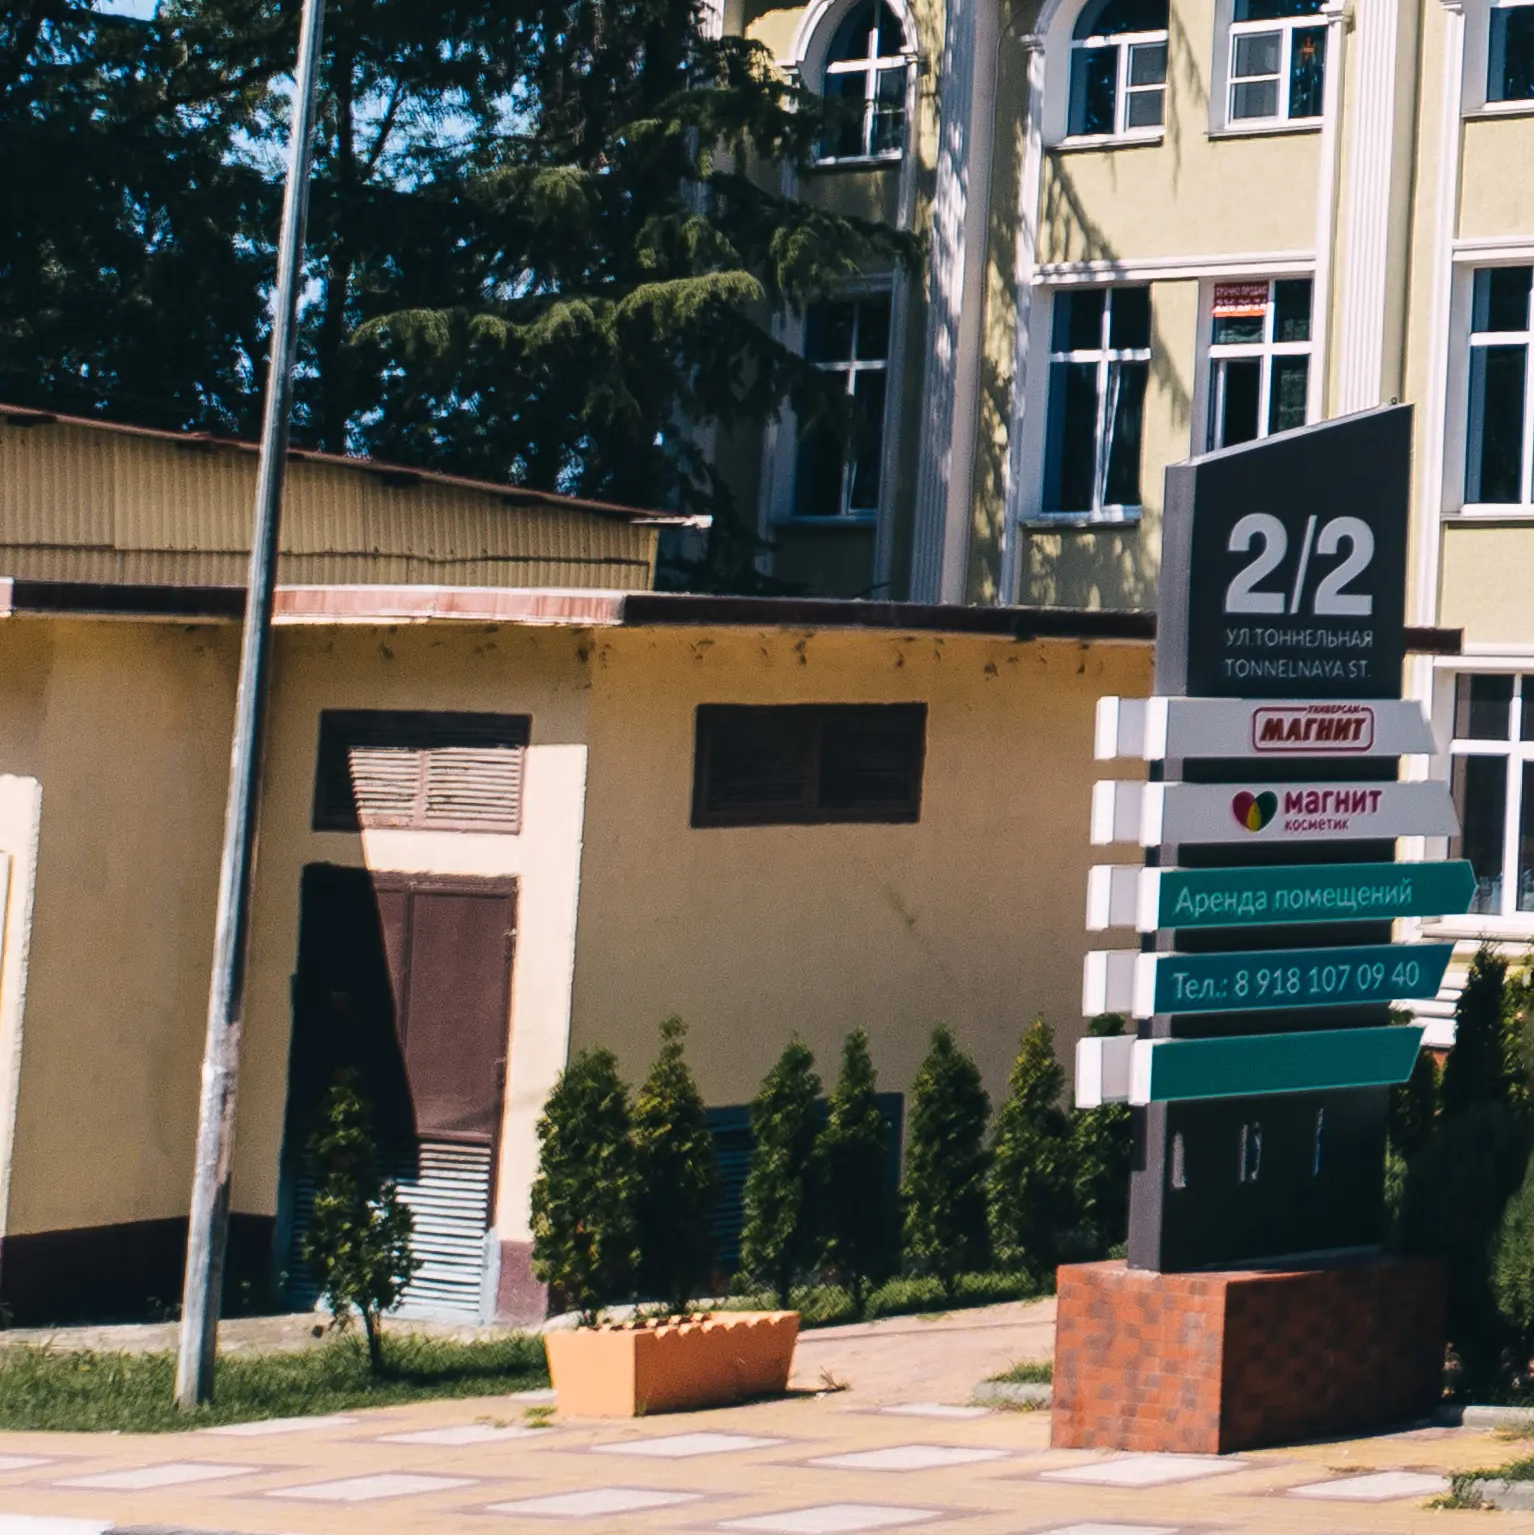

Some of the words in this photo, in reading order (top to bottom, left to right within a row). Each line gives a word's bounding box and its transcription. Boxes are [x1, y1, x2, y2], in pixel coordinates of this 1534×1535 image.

[1225, 512, 1375, 615] 2/2
[1225, 658, 1344, 678] TONNELNAYA
[1348, 660, 1372, 678] ST.
[1259, 717, 1367, 742] МАГНИТ
[1284, 789, 1383, 814] магнит
[1284, 817, 1350, 832] косметик
[1174, 885, 1268, 917] Аренда
[1275, 877, 1413, 908] помещений
[1173, 971, 1228, 999] Тел.:
[1234, 969, 1249, 996] 8
[1256, 968, 1300, 997] 918
[1308, 964, 1351, 994] 107
[1357, 962, 1386, 991] 09
[1391, 960, 1419, 989] 40
